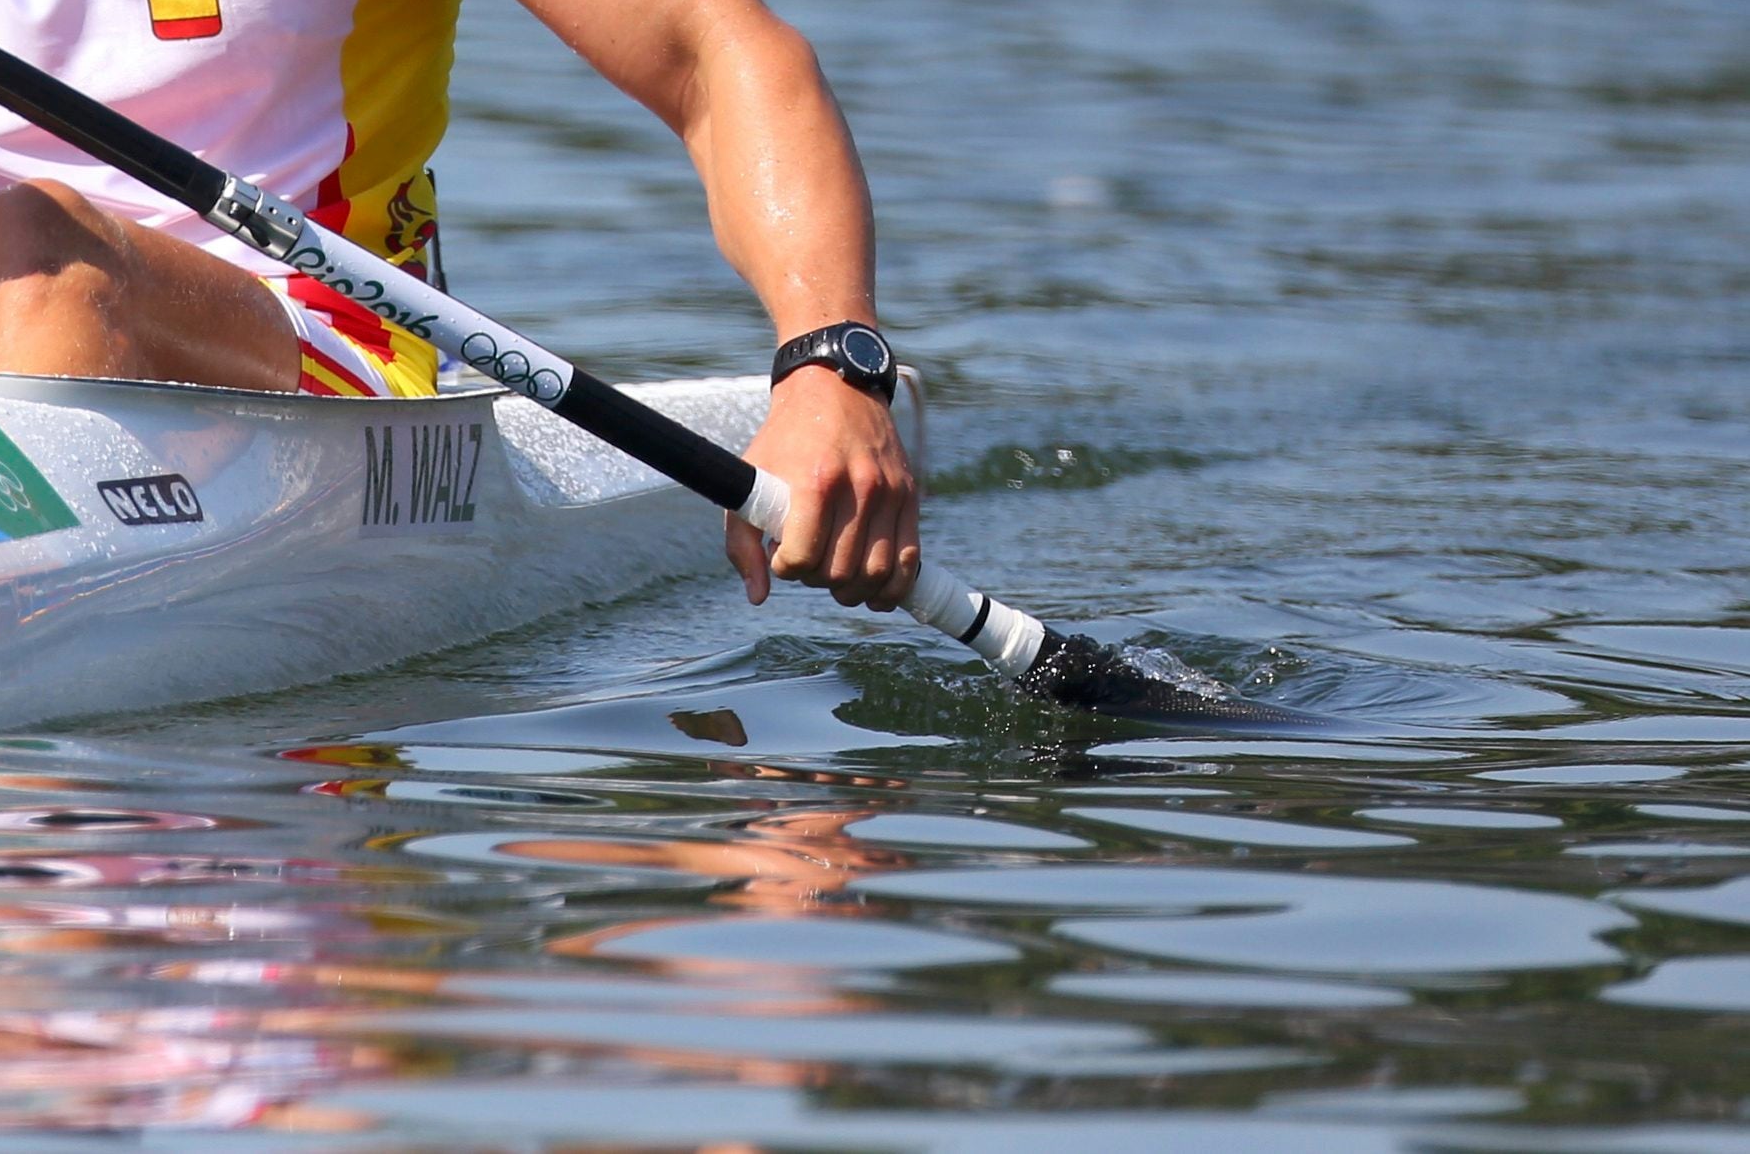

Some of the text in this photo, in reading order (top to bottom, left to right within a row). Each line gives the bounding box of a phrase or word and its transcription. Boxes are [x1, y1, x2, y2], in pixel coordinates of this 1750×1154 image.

[103, 479, 200, 521] NELO
[362, 423, 483, 526] M. WALZ
